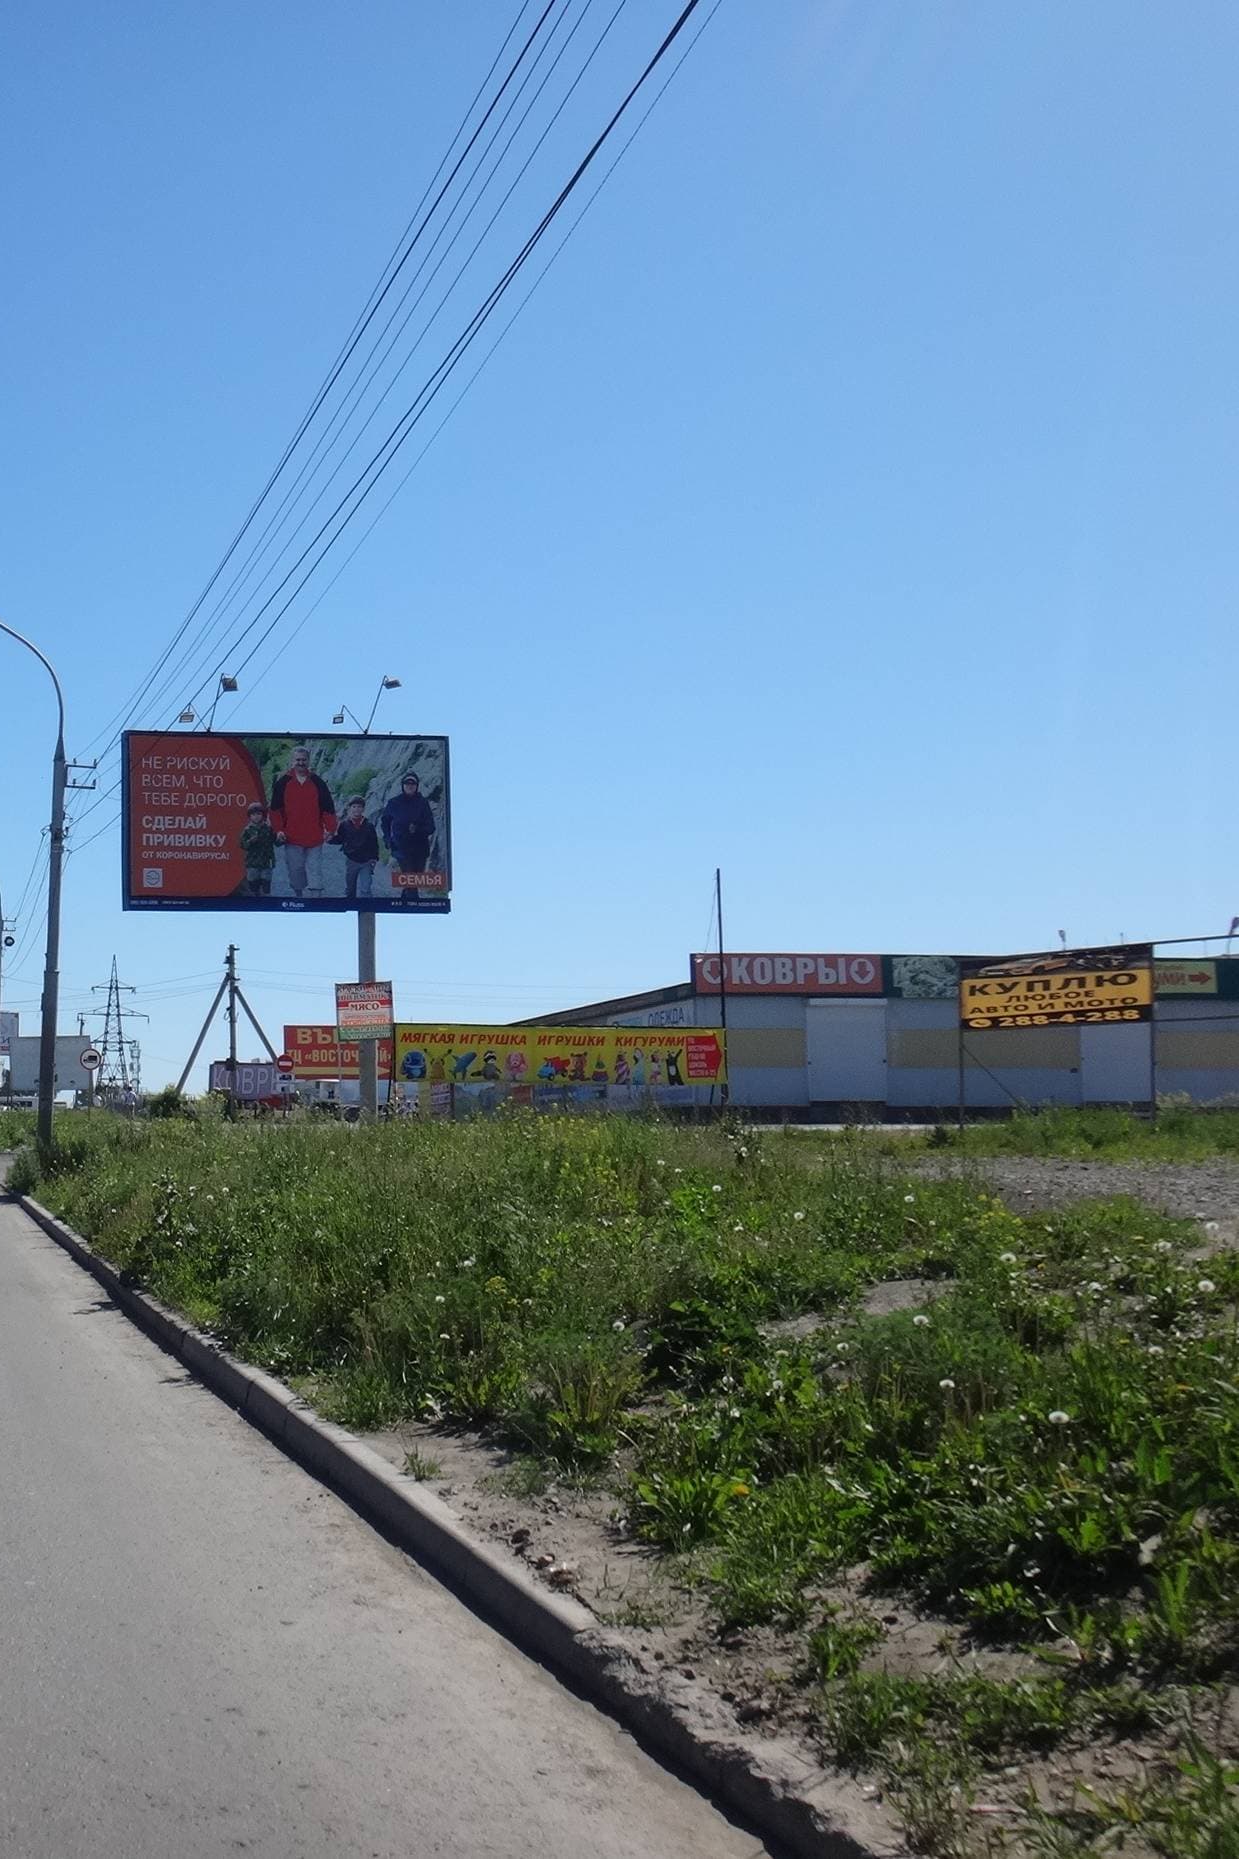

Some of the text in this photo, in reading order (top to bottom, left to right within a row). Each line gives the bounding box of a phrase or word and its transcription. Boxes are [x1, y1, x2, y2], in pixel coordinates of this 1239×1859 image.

[142, 755, 231, 770] НЕ РИСКУЙ
[142, 774, 224, 789] ВСЕМ, ЧТО
[142, 792, 247, 808] ТЕБЕ ДОРОГО
[142, 814, 206, 831] СДЕЛАЙ
[142, 833, 226, 847] ПРИВИВКУ
[142, 851, 230, 860] ОТ КОРОНАВИРУСА!
[398, 874, 442, 886] СЕМЬЯ
[731, 957, 848, 985] КОВРЫ
[968, 972, 1139, 997] КУПЛЮ
[1004, 989, 1096, 1004] ЛЮБОЕ
[350, 1002, 380, 1011] МЯСО
[969, 997, 1139, 1015] АВТО И МОТО
[998, 1009, 1141, 1028] 288-4-288
[400, 1032, 456, 1044] МЯГКАЯ
[459, 1033, 527, 1046] ИГРУШКА
[536, 1035, 606, 1047] ИГРУШКИ
[614, 1036, 686, 1047] КИГУРУМИ
